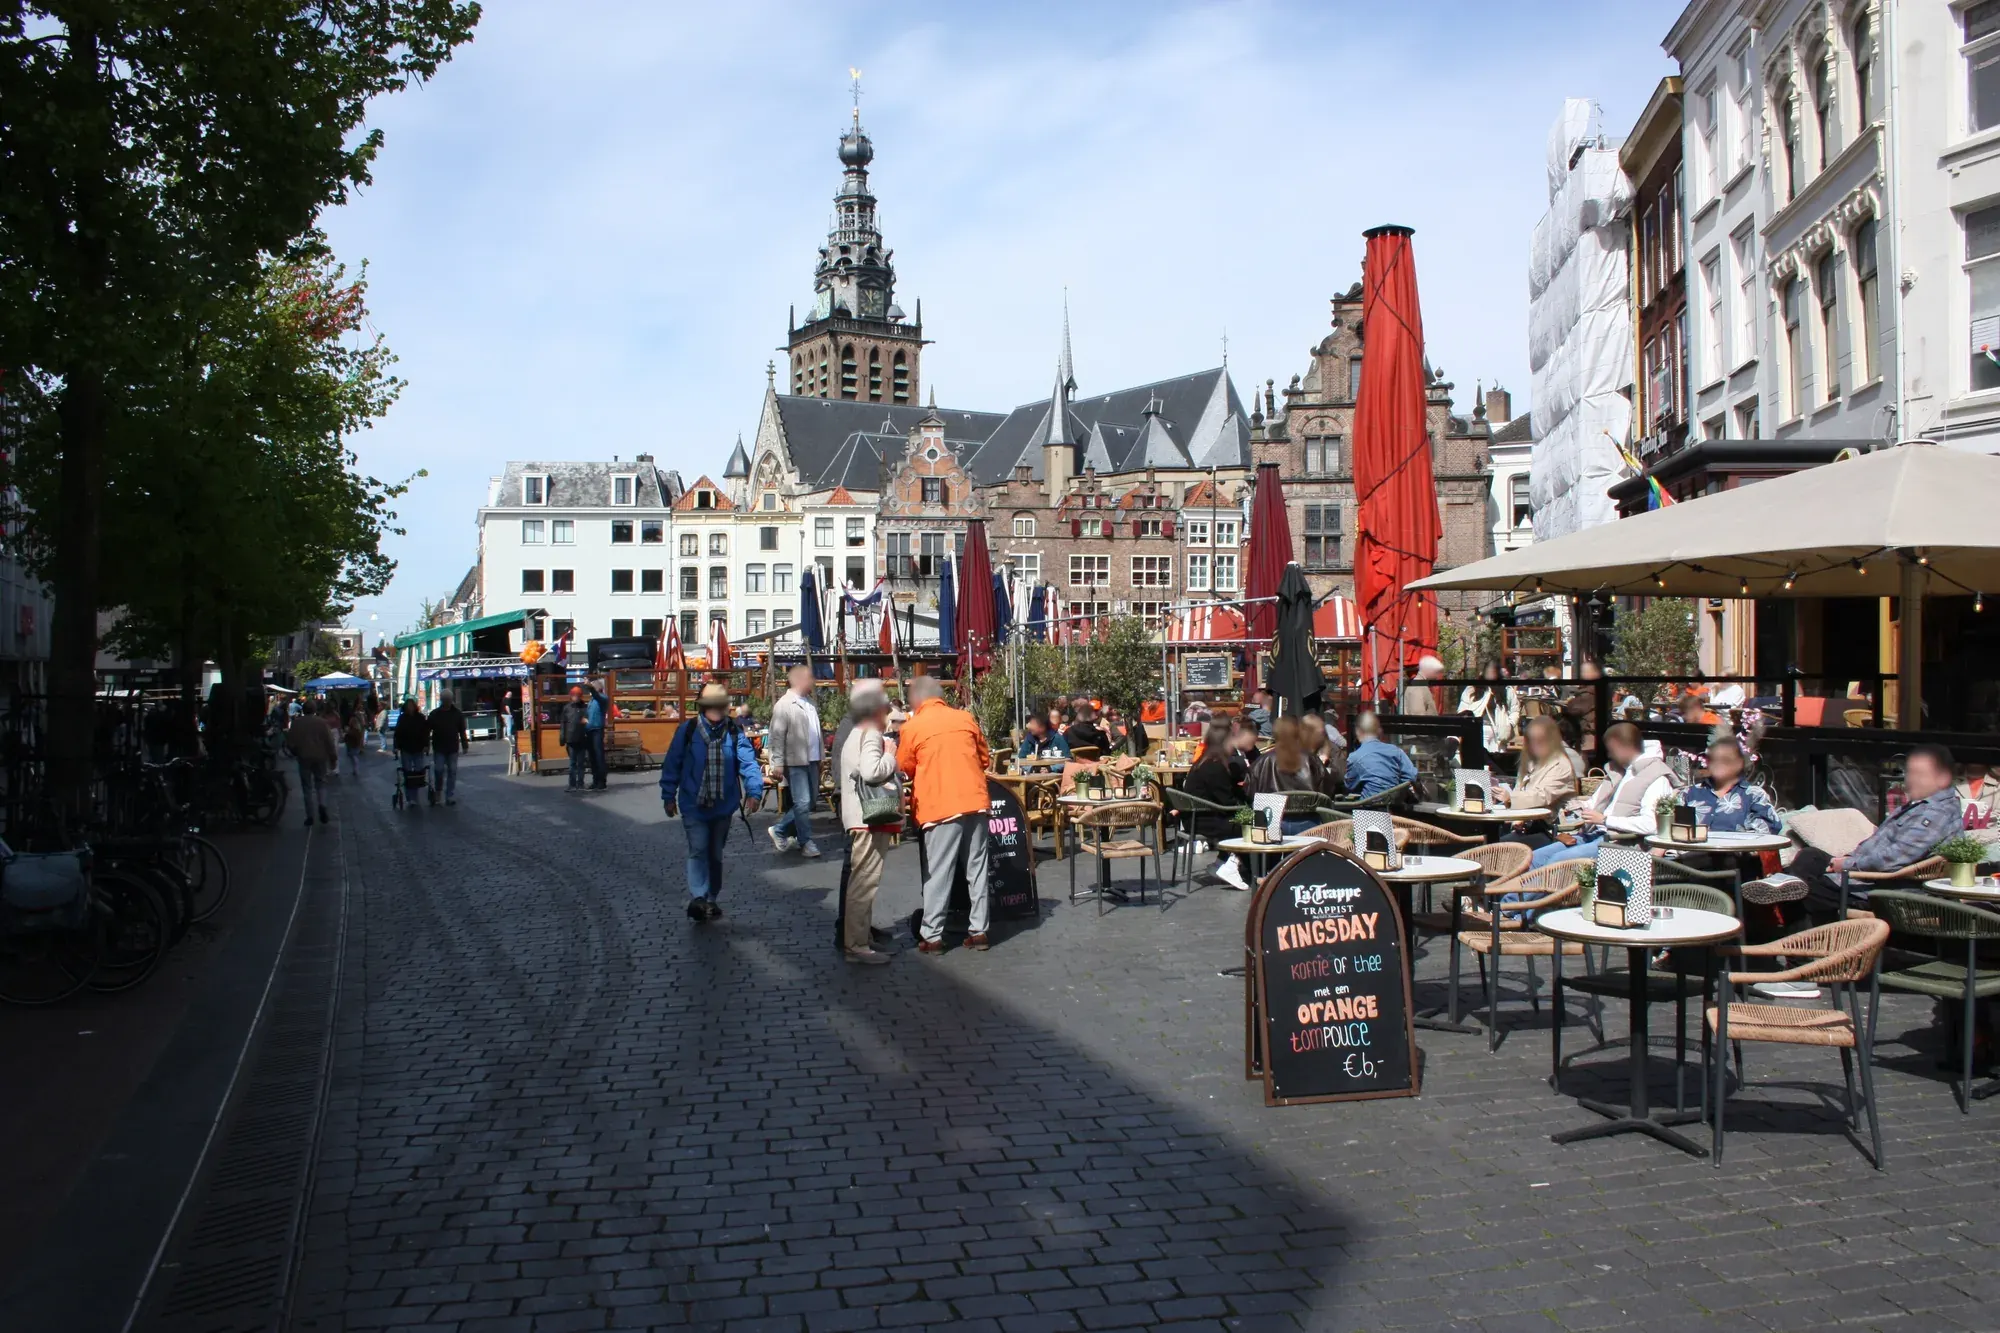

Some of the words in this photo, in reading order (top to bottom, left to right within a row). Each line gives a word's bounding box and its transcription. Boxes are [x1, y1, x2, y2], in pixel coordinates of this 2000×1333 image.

[988, 817, 1018, 836] ODJE
[1301, 904, 1354, 916] TRAPPIST
[1276, 912, 1379, 951] KINGSDAY
[1353, 954, 1382, 973] thee
[1313, 986, 1331, 998] met
[1334, 984, 1350, 995] een
